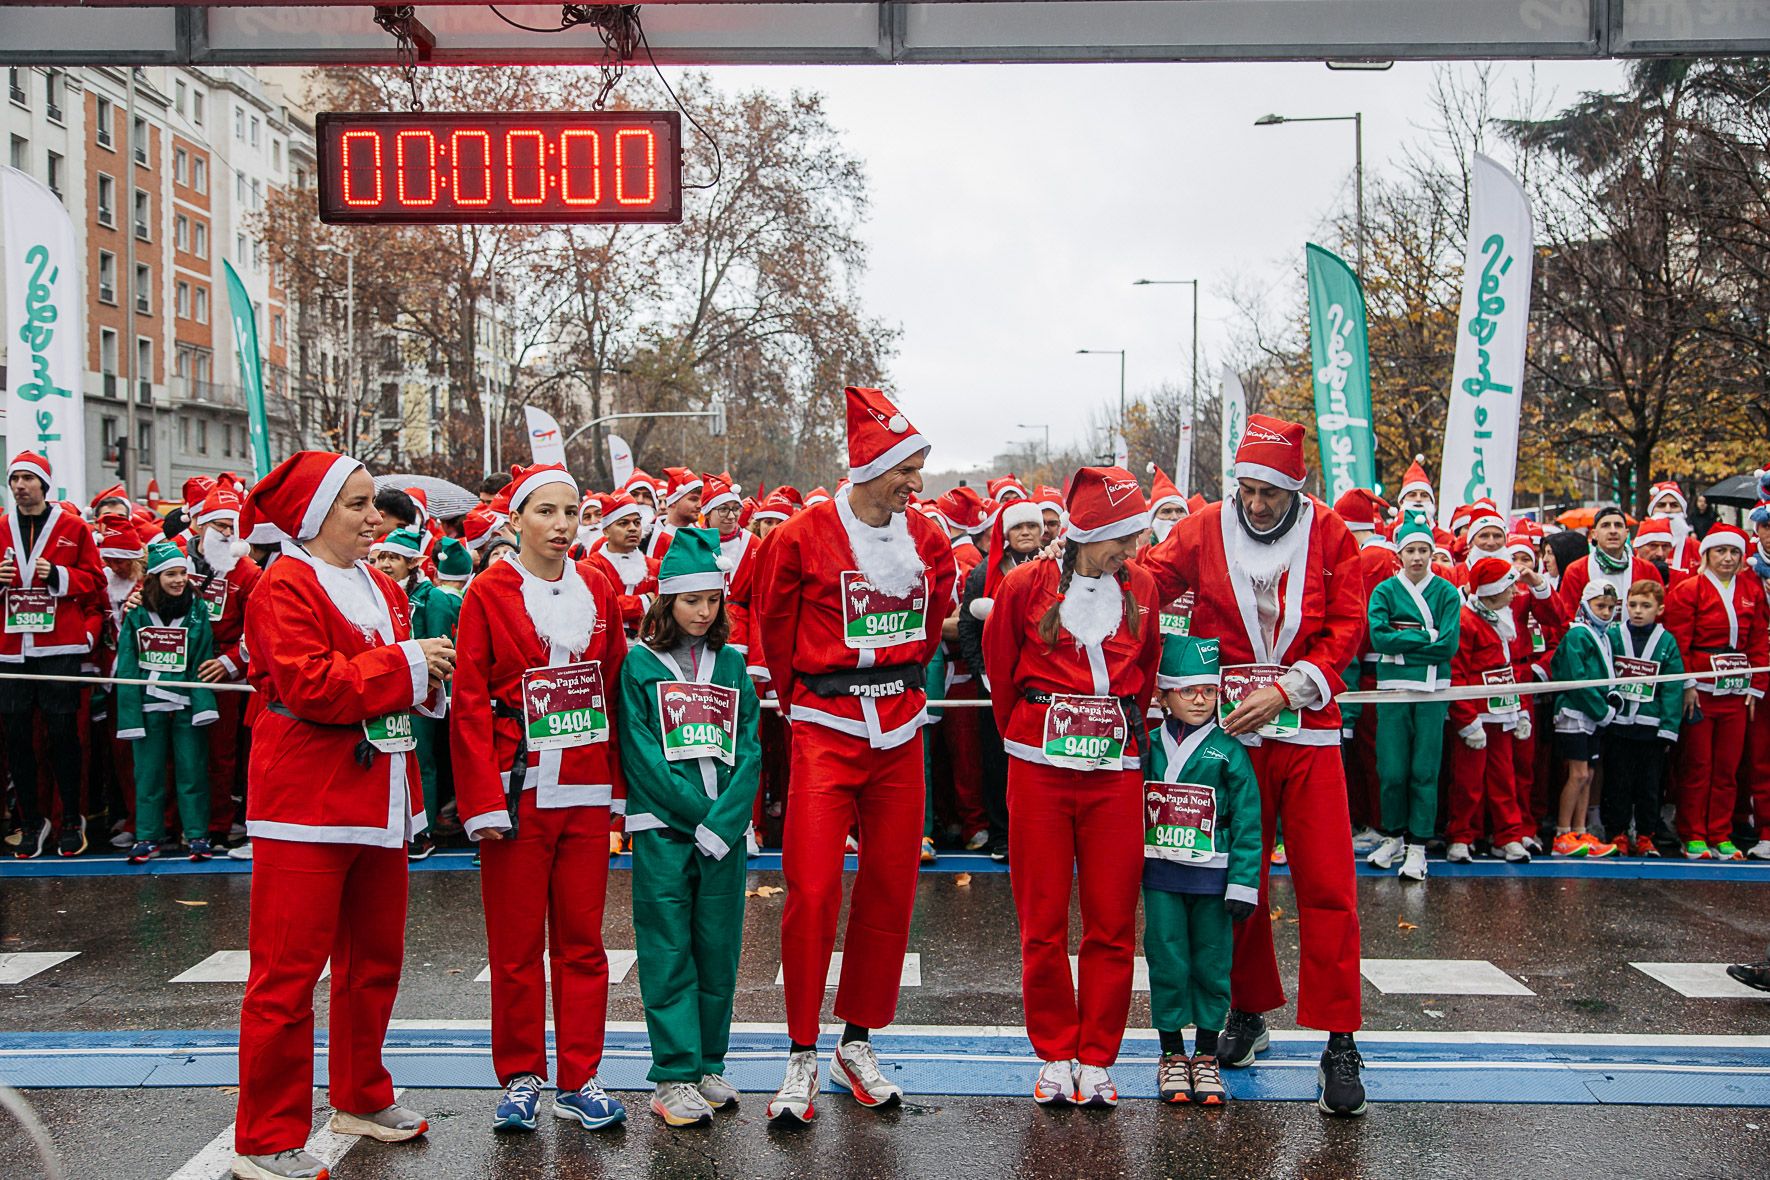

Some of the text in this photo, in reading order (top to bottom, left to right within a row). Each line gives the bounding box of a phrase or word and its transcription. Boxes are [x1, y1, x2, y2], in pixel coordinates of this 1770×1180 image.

[341, 129, 656, 207] 00:00:00
[15, 612, 45, 625] 5304
[865, 612, 909, 635] 9407
[1159, 613, 1186, 628] 9735
[144, 651, 178, 664] 10240
[555, 673, 596, 689] Papá Noel
[1249, 674, 1272, 684] Papá
[691, 692, 714, 704] Papá
[713, 696, 730, 708] Noel
[1078, 705, 1102, 716] Papá
[548, 710, 592, 735] 9404
[682, 724, 723, 747] 9406
[1064, 736, 1111, 757] 9409
[1166, 793, 1211, 807] Papá Noel
[1155, 826, 1197, 848] 9408
